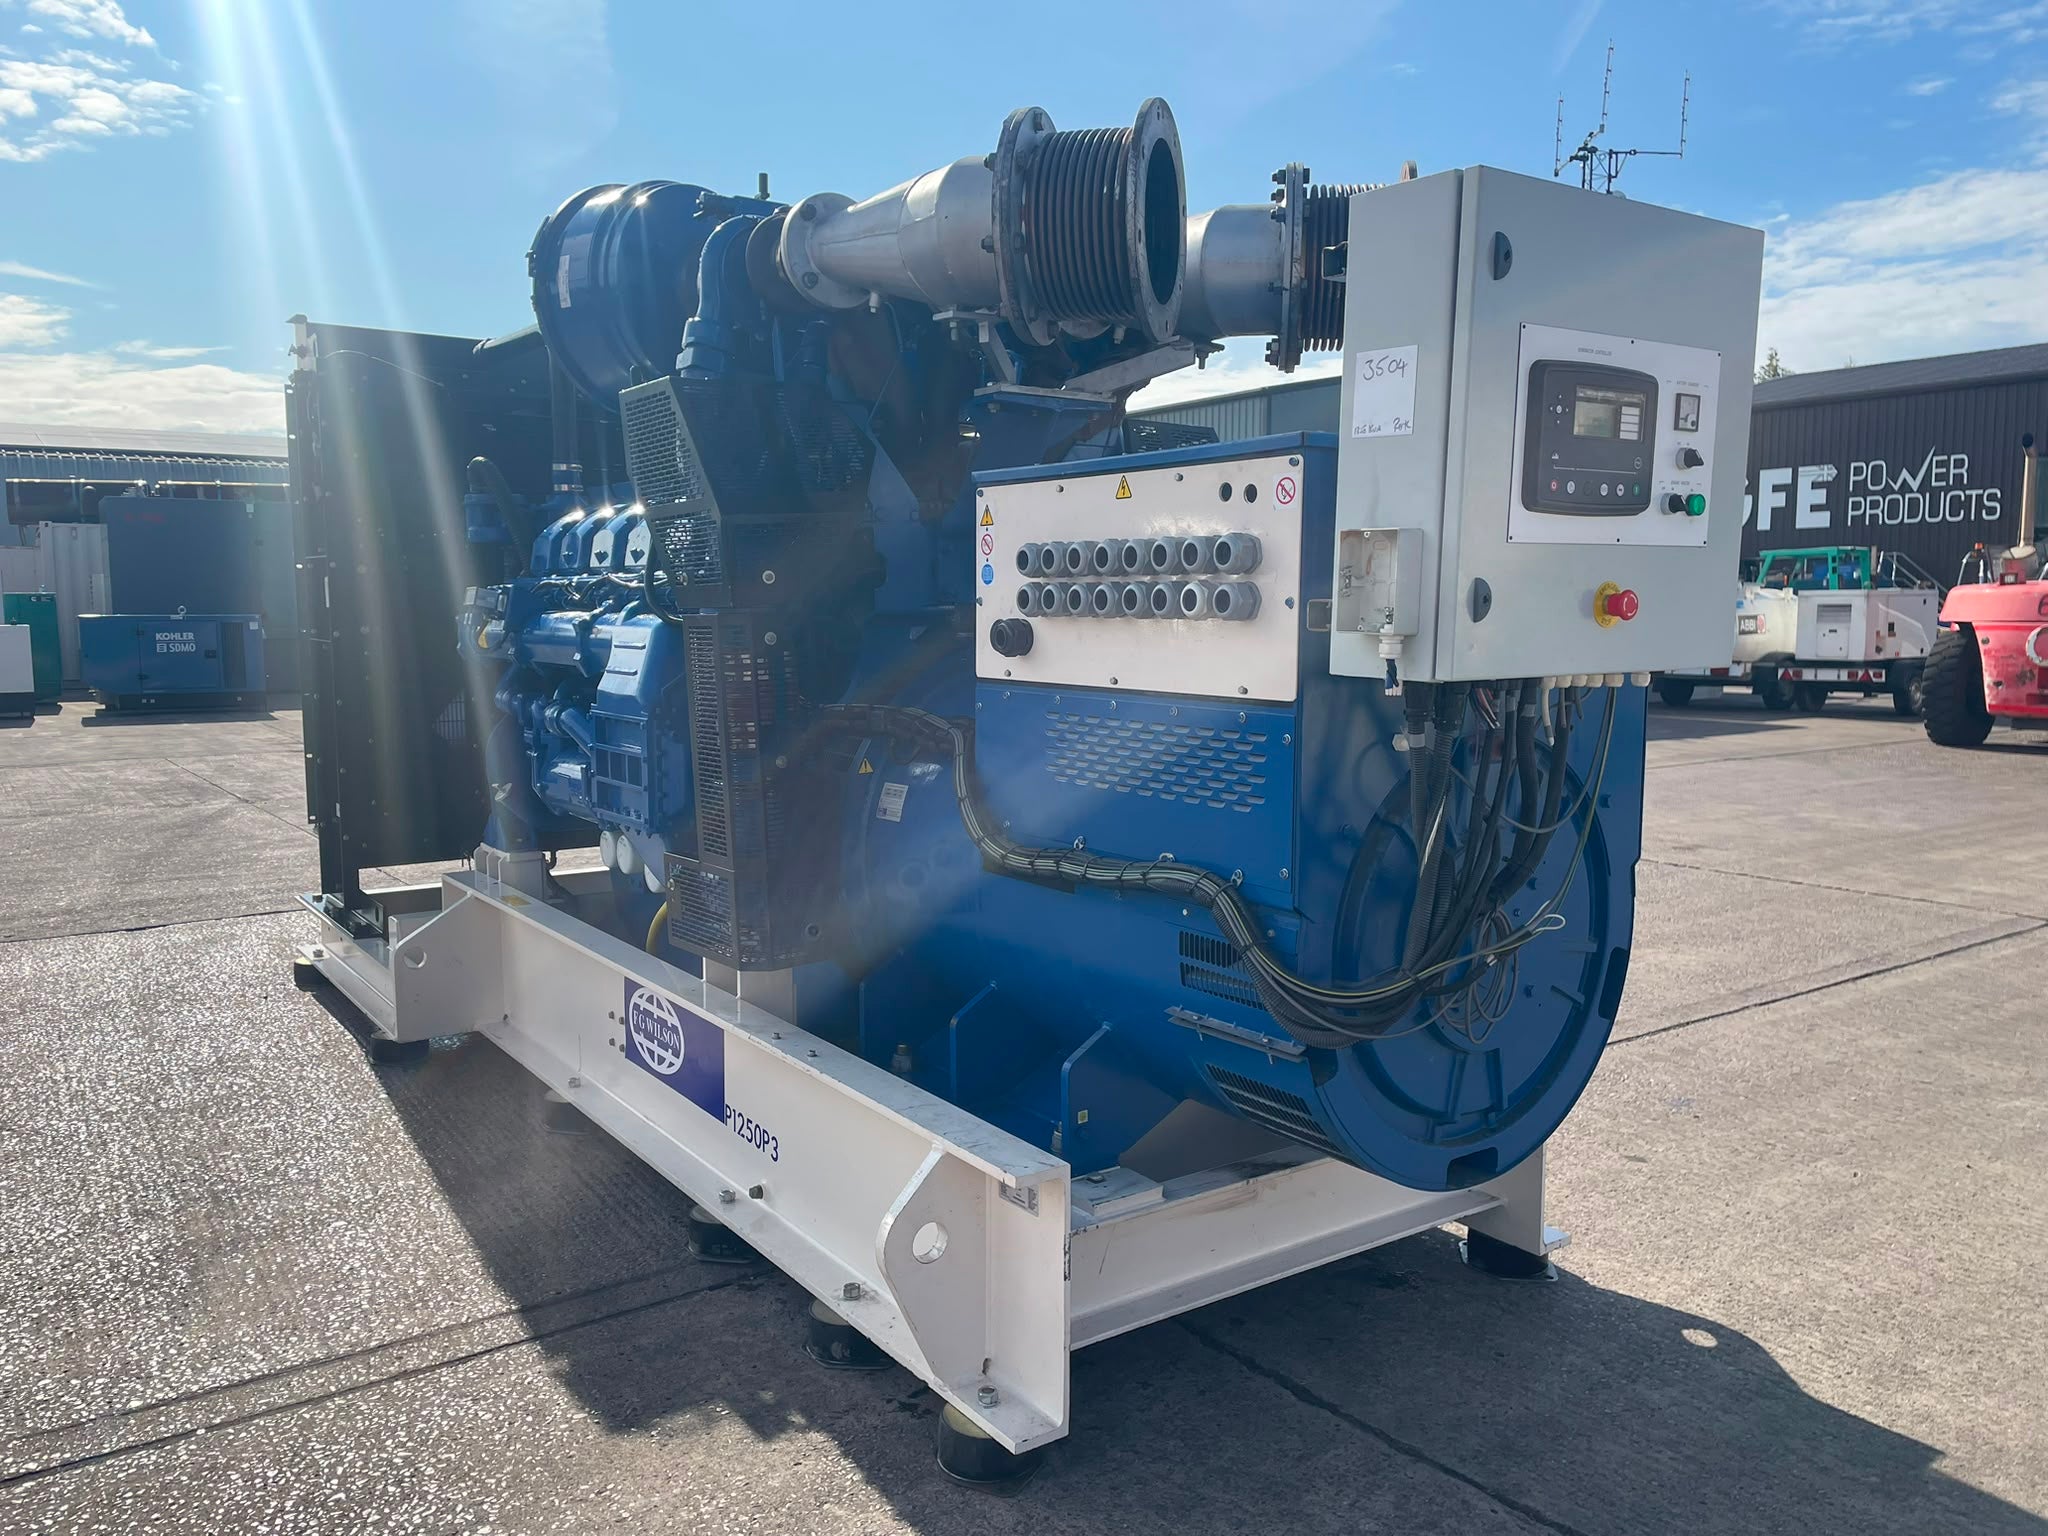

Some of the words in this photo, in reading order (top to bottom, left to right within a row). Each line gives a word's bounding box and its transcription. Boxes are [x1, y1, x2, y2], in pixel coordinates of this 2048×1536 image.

[1363, 355, 1408, 381] 3504
[1849, 446, 1969, 492] POWER
[1847, 487, 2002, 527] PRODUCTS
[155, 632, 195, 641] KOHLER
[169, 643, 196, 652] SDMO
[645, 1016, 680, 1051] WILSON
[725, 1104, 779, 1163] P1250P3
